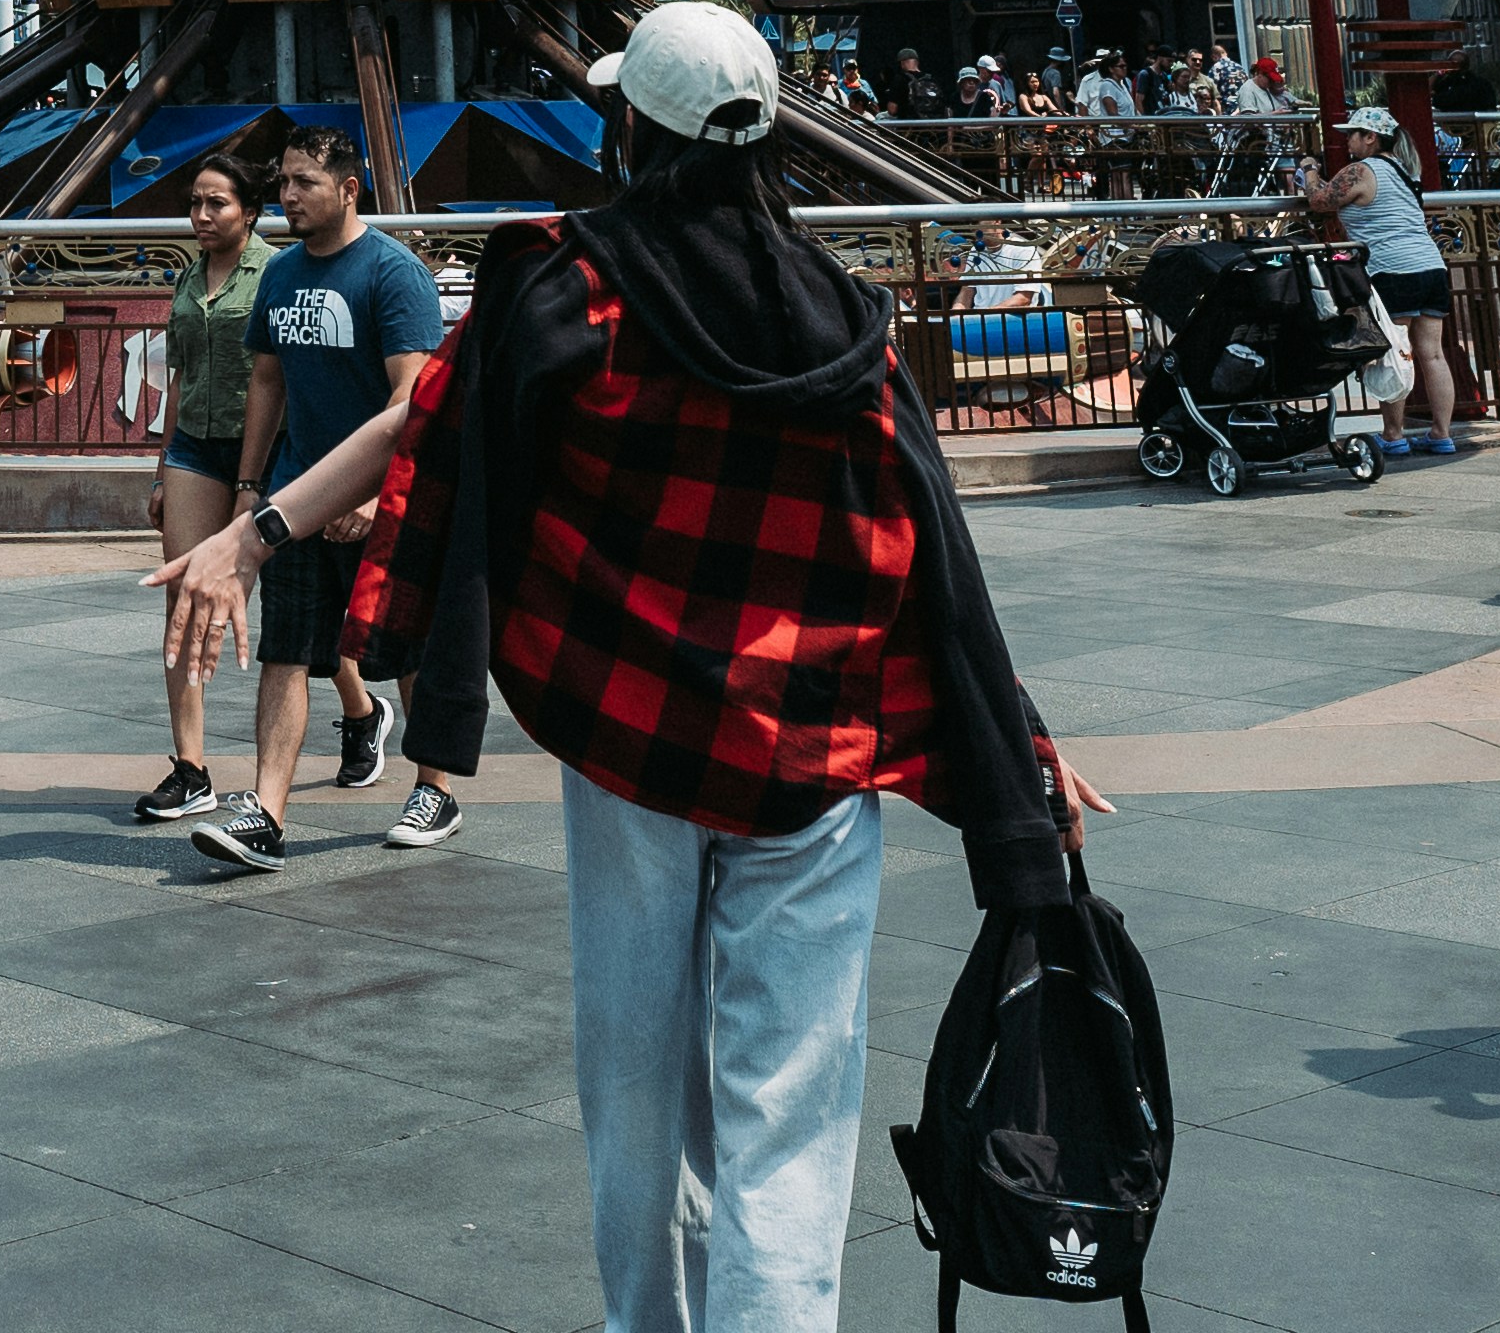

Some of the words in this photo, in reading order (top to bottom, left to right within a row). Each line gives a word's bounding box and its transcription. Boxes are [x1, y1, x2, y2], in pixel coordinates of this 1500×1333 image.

[295, 288, 327, 307] THE
[269, 306, 321, 326] NORTH
[278, 325, 320, 345] FACE
[1046, 1269, 1096, 1288] adidas
